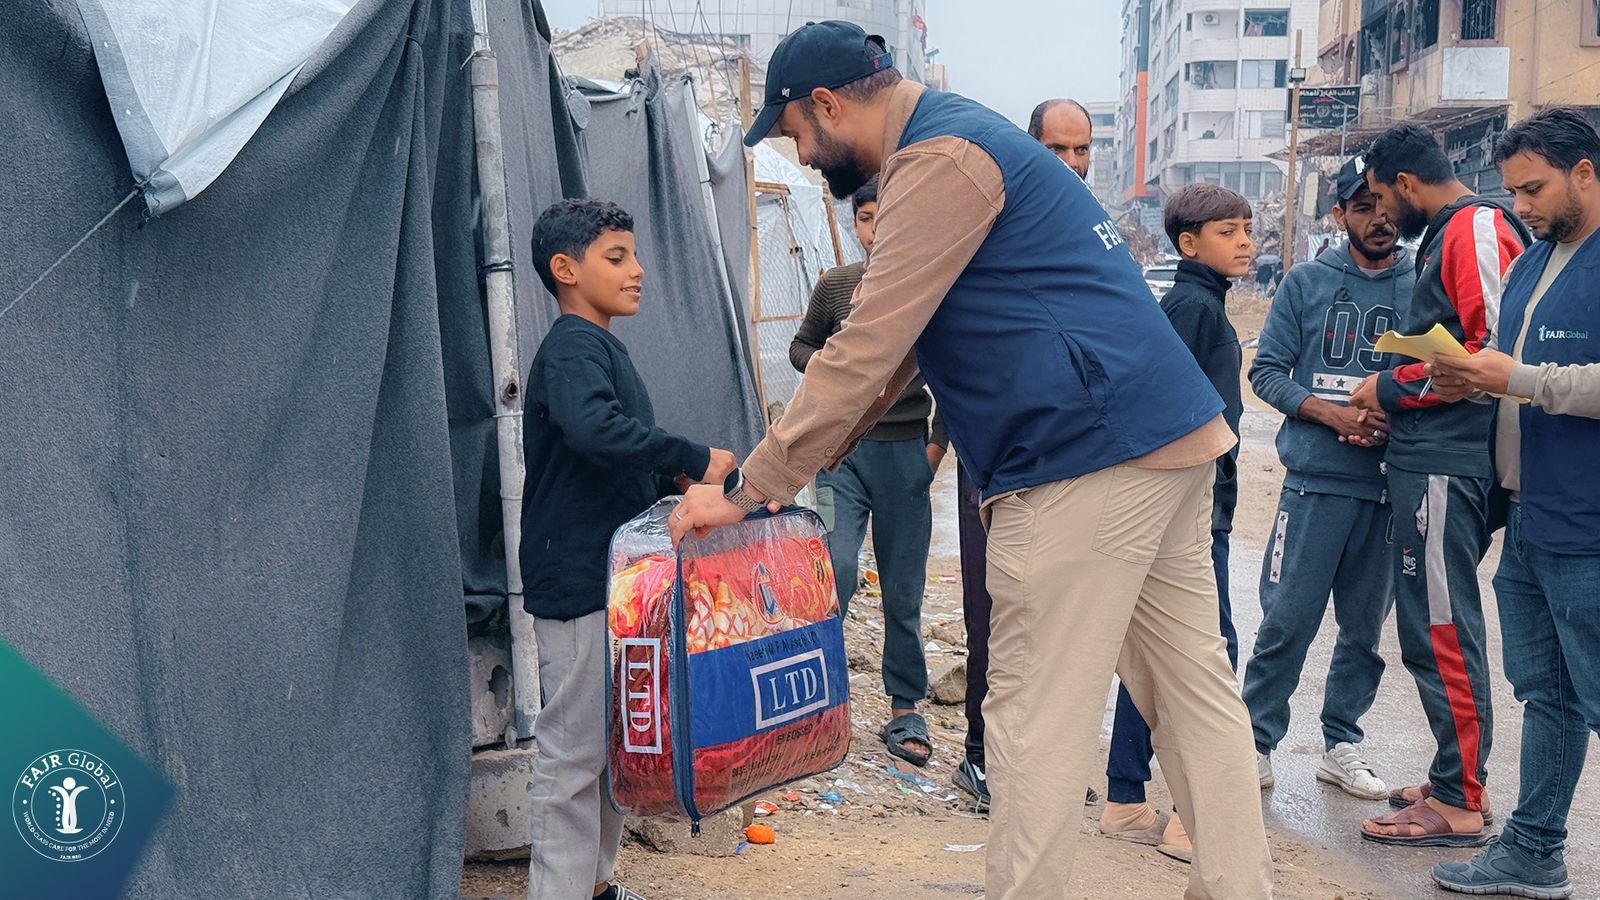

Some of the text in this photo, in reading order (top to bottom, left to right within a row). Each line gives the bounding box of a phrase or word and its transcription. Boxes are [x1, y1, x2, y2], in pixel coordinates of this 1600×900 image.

[1321, 301, 1402, 373] 09
[628, 660, 652, 733] LTD
[769, 667, 818, 711] LTD
